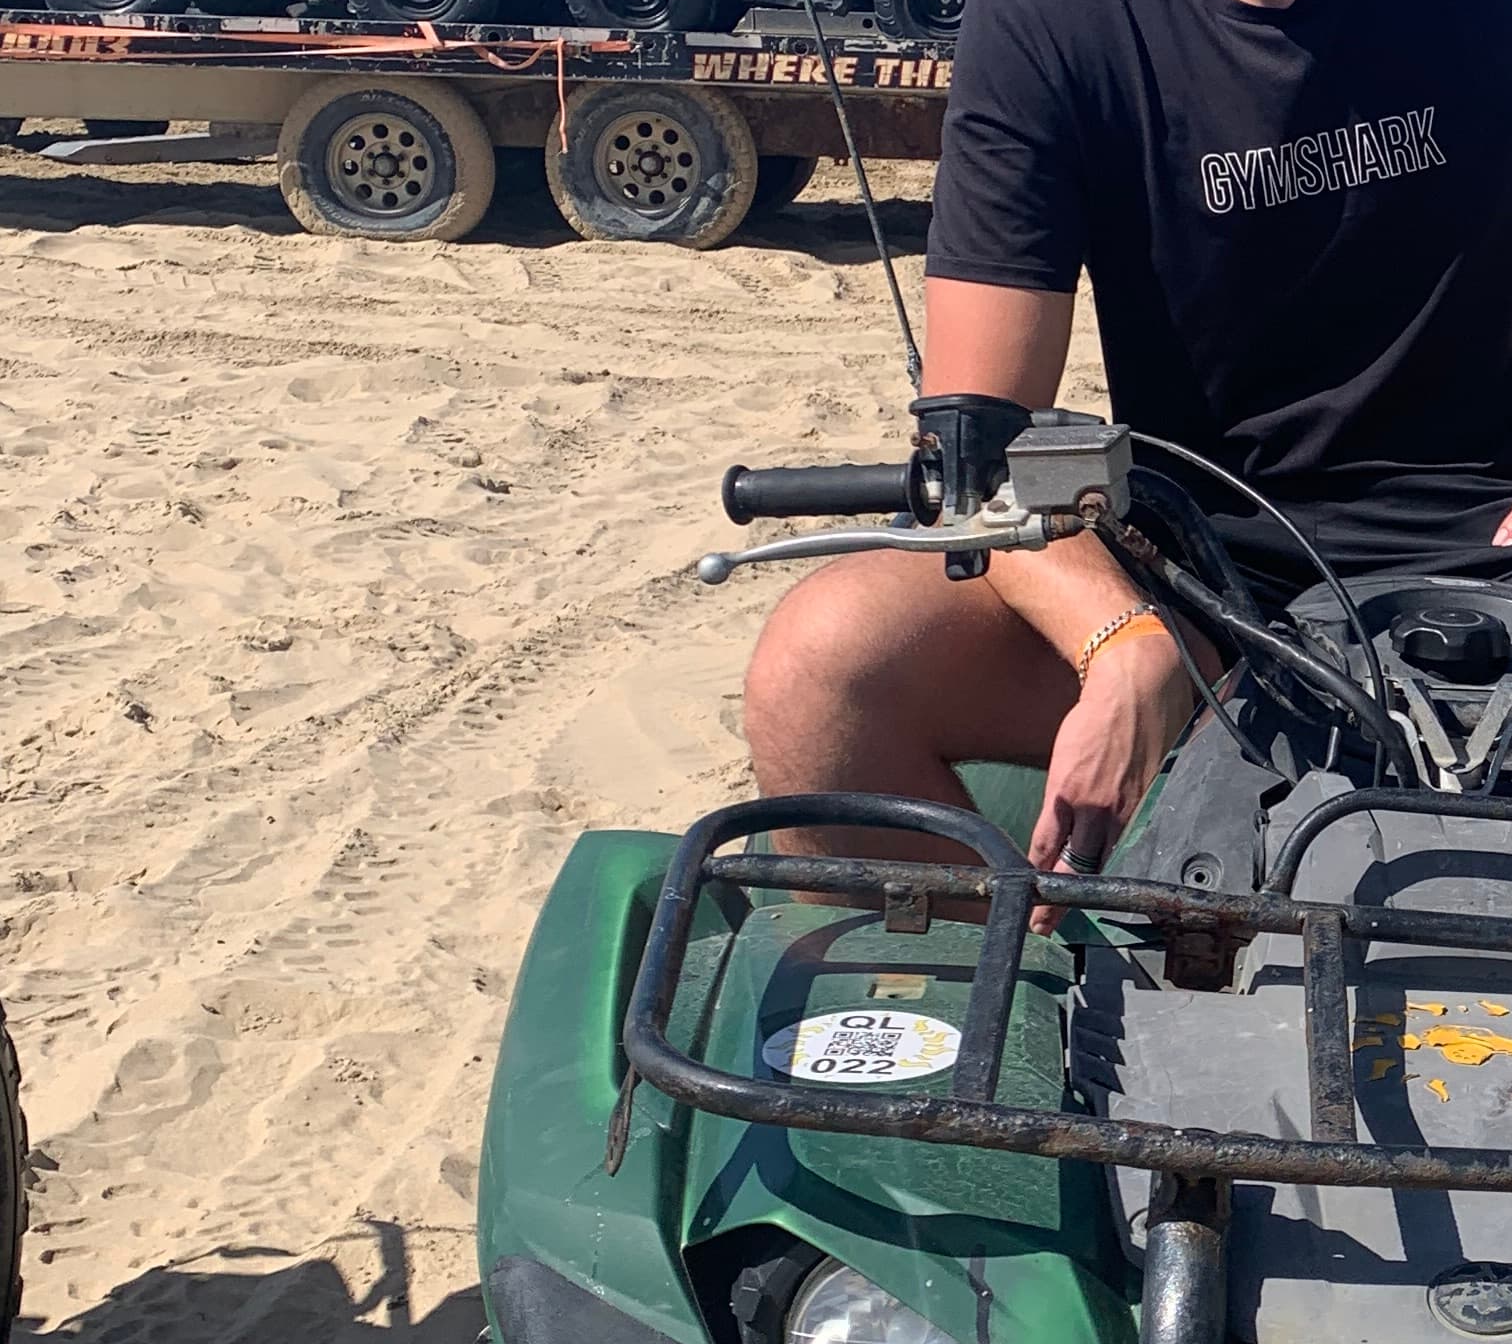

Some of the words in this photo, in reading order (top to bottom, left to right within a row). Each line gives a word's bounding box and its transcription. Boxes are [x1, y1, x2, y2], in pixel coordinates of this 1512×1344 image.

[694, 53, 858, 85] WHERE
[1200, 106, 1447, 214] GYMSHARK
[839, 1015, 906, 1030] QL
[810, 1058, 897, 1075] 022
